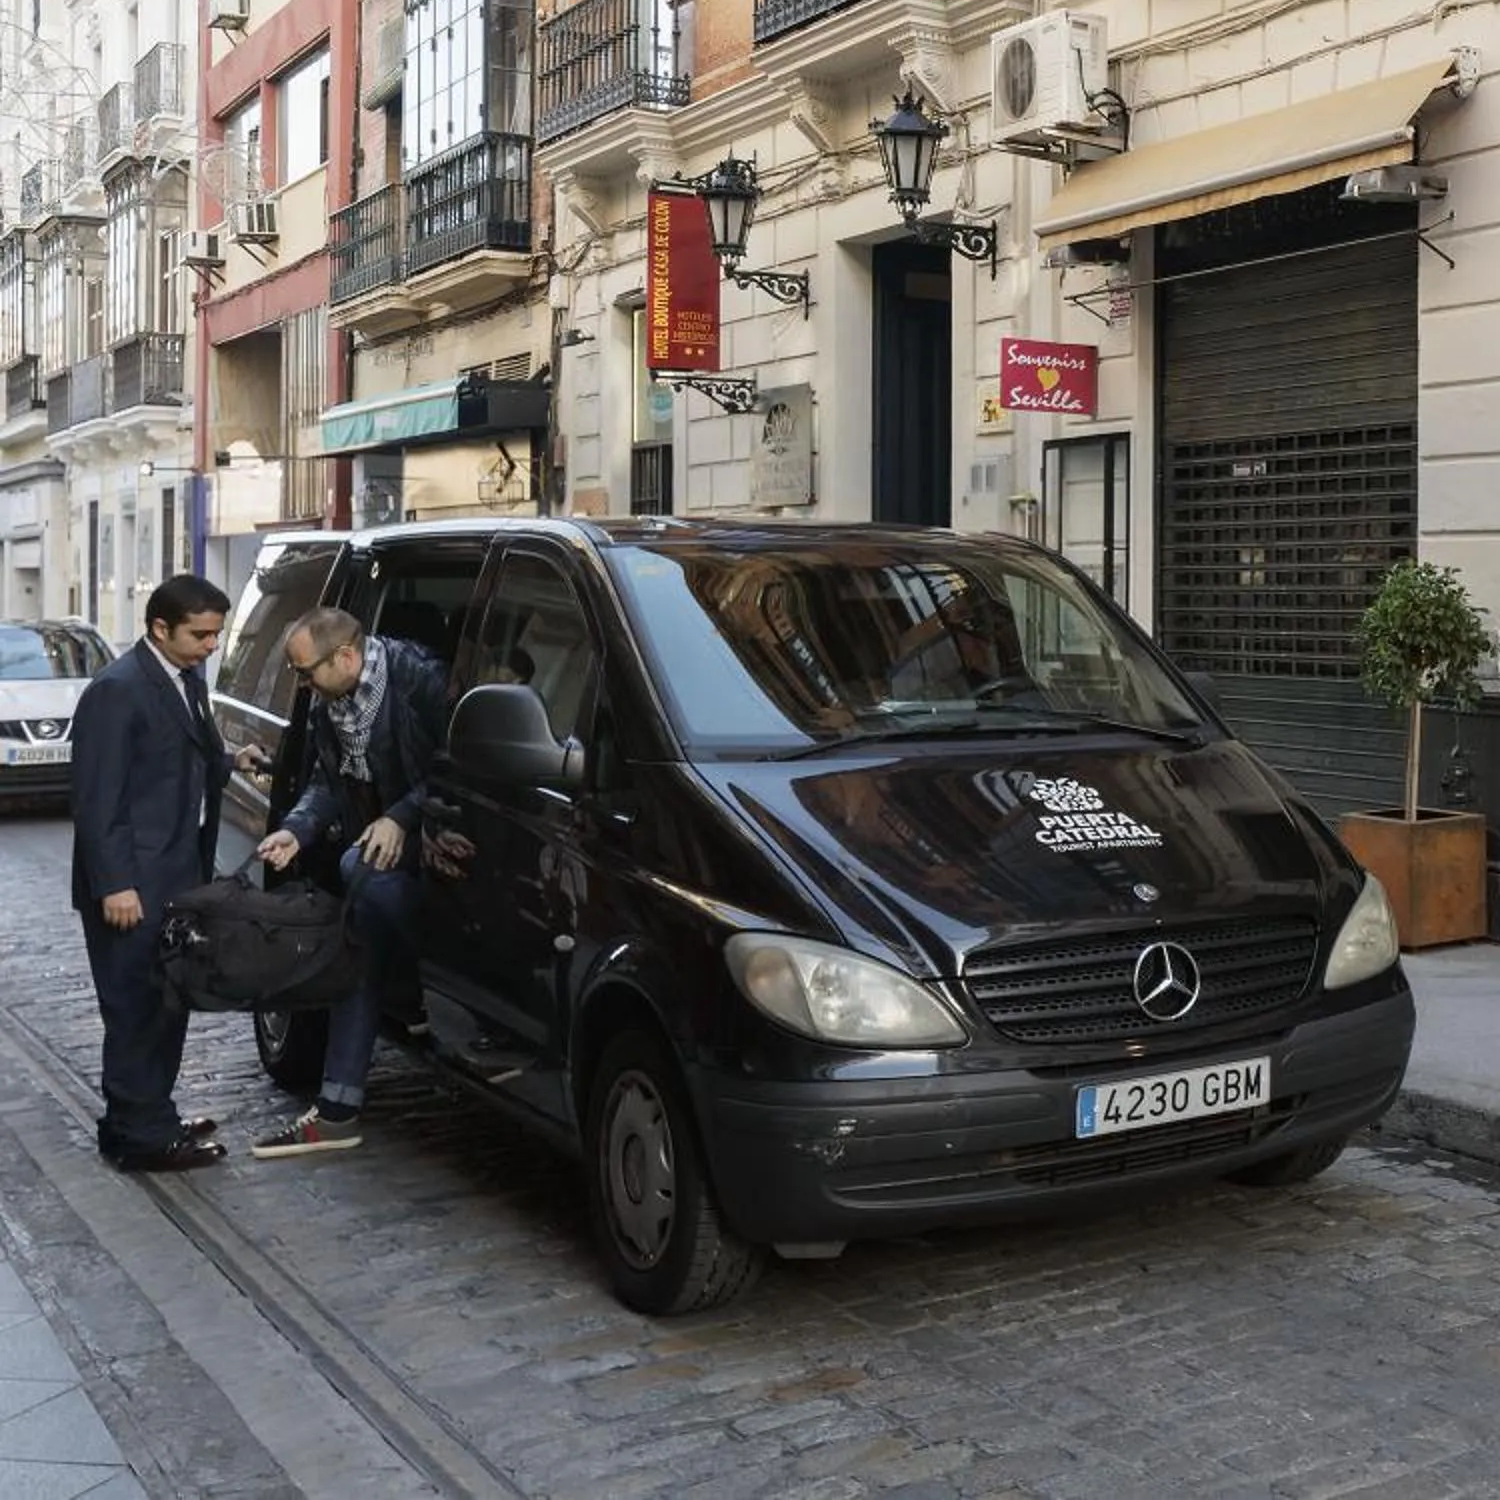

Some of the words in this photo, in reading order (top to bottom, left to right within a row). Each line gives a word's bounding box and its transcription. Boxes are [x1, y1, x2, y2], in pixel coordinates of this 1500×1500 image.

[654, 235, 669, 247] DE
[653, 250, 669, 276] CASA
[653, 277, 672, 327] BOUTIQUE
[653, 327, 669, 359] HOTEL
[1007, 343, 1087, 371] Souvenirs
[1009, 385, 1083, 409] Sevilla
[1039, 811, 1137, 829] PUERTA
[1034, 824, 1162, 844] CATEDRAL
[1049, 841, 1096, 853] TOURIST
[1103, 1077, 1190, 1125] 4230
[1202, 1064, 1262, 1108] GBM
